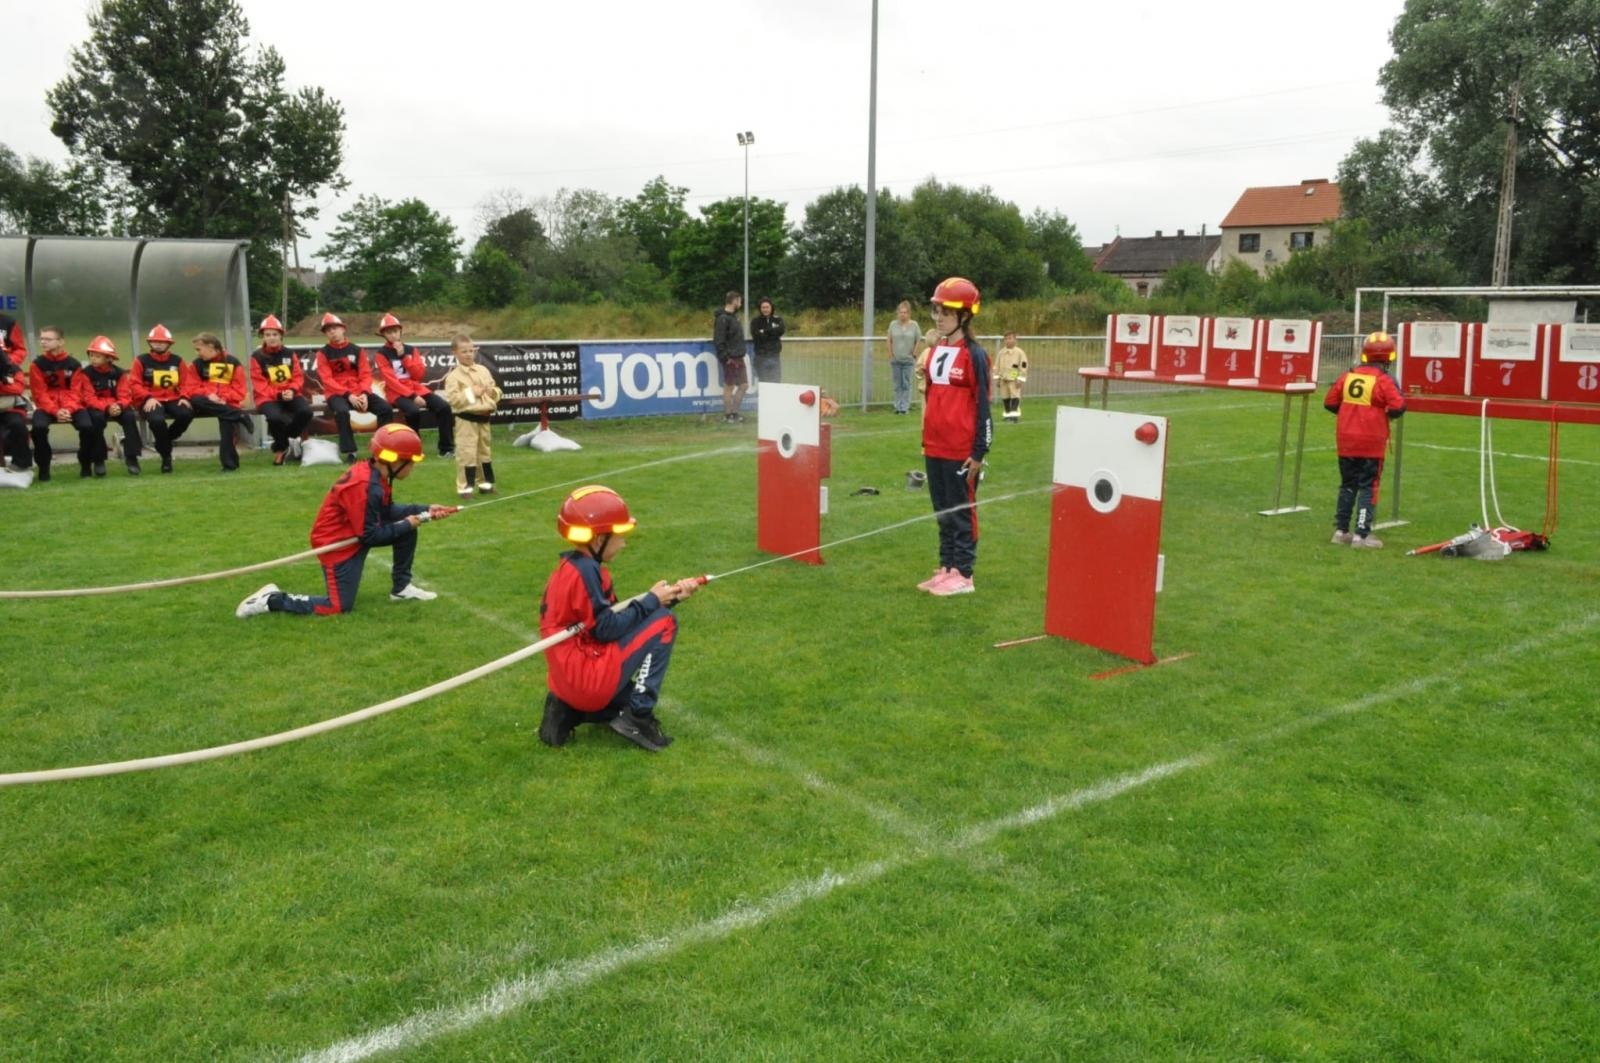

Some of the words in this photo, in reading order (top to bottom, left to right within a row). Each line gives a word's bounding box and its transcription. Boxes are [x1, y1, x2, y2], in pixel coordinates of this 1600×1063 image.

[523, 352, 540, 361] 603
[542, 351, 558, 360] 798
[560, 351, 576, 359] 967
[936, 352, 949, 377] 1
[1126, 346, 1138, 363] 2
[1174, 348, 1186, 368] 3
[1225, 351, 1237, 371] 4
[1280, 354, 1294, 375] 5
[216, 367, 229, 379] 7
[275, 369, 287, 383] 8
[526, 364, 541, 372] 607
[545, 363, 561, 371] 336
[1425, 359, 1444, 383] 6
[1500, 362, 1516, 386] 7
[1577, 365, 1599, 390] 8
[160, 374, 172, 389] 6
[526, 378, 542, 386] 603
[545, 377, 561, 385] 798
[562, 376, 578, 384] 977
[1348, 378, 1364, 398] 6
